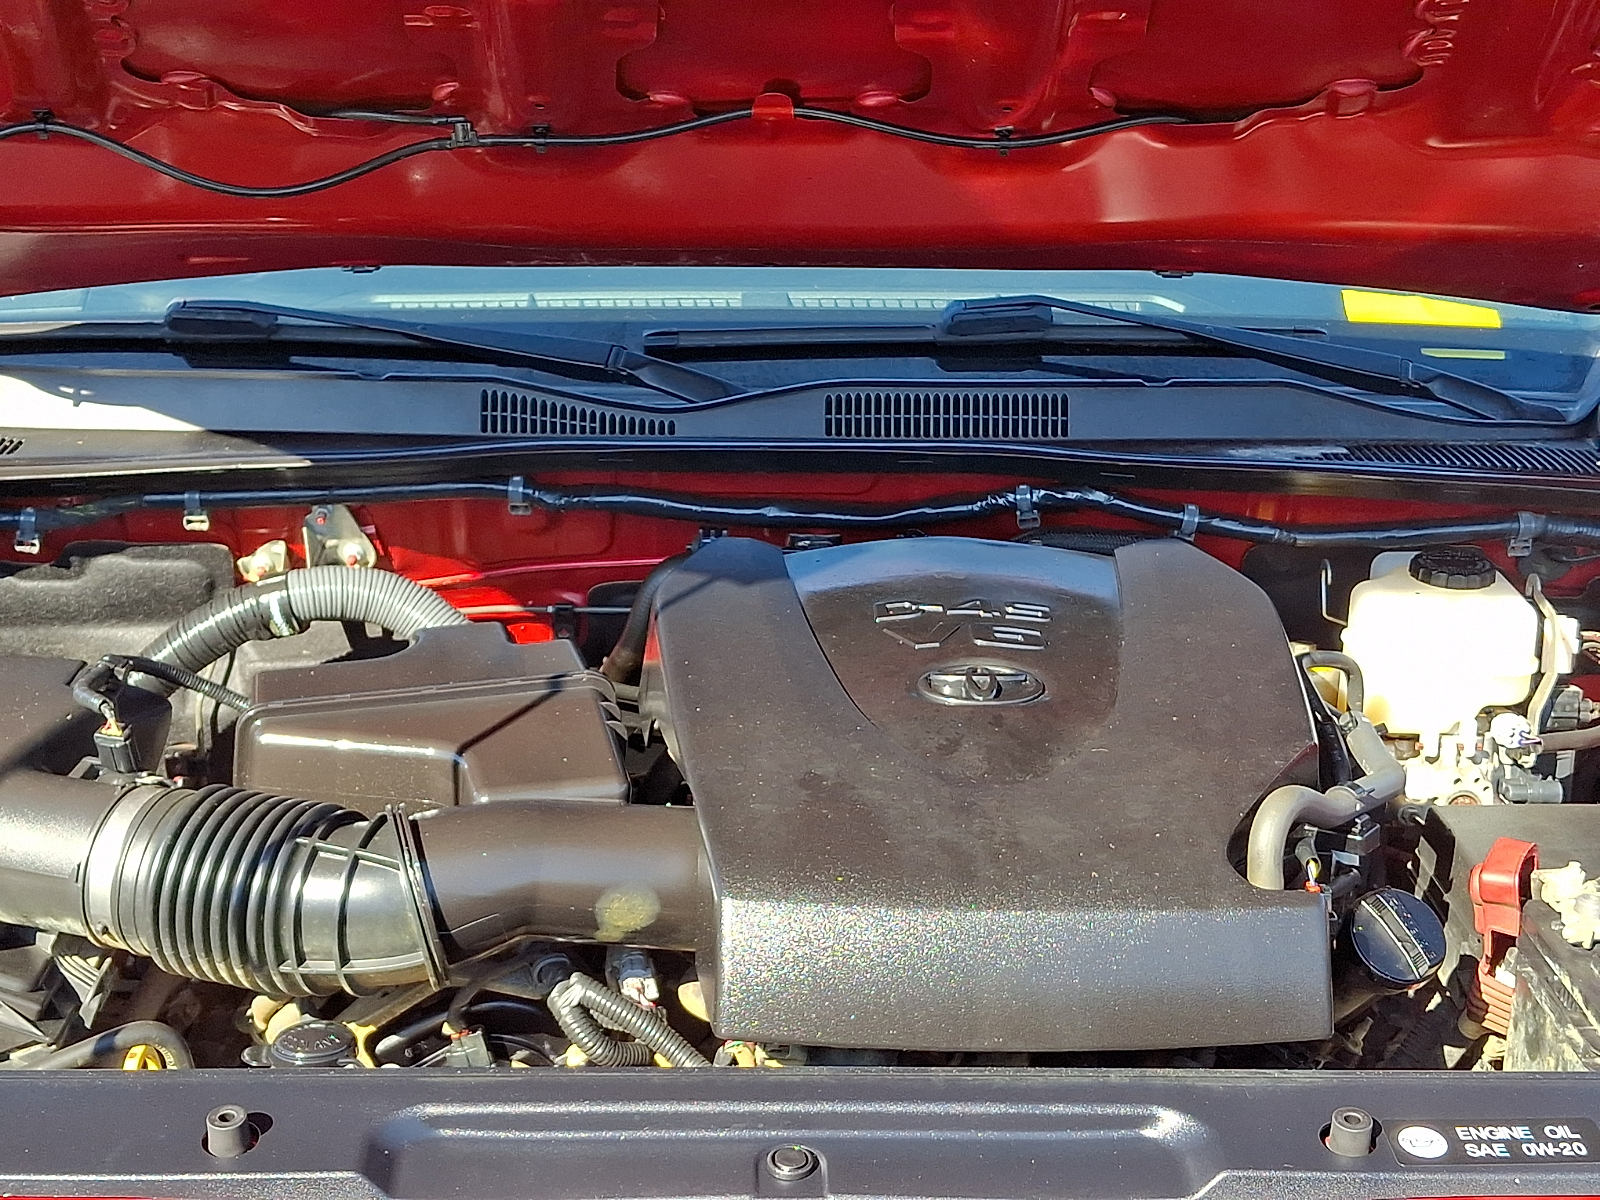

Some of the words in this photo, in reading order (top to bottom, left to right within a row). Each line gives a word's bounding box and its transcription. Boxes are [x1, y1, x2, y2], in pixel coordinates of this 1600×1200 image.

[1454, 1126, 1535, 1141] ENGINE
[1543, 1125, 1582, 1139] OIL
[1463, 1143, 1511, 1157] SAE
[1521, 1142, 1588, 1157] 0W-20
